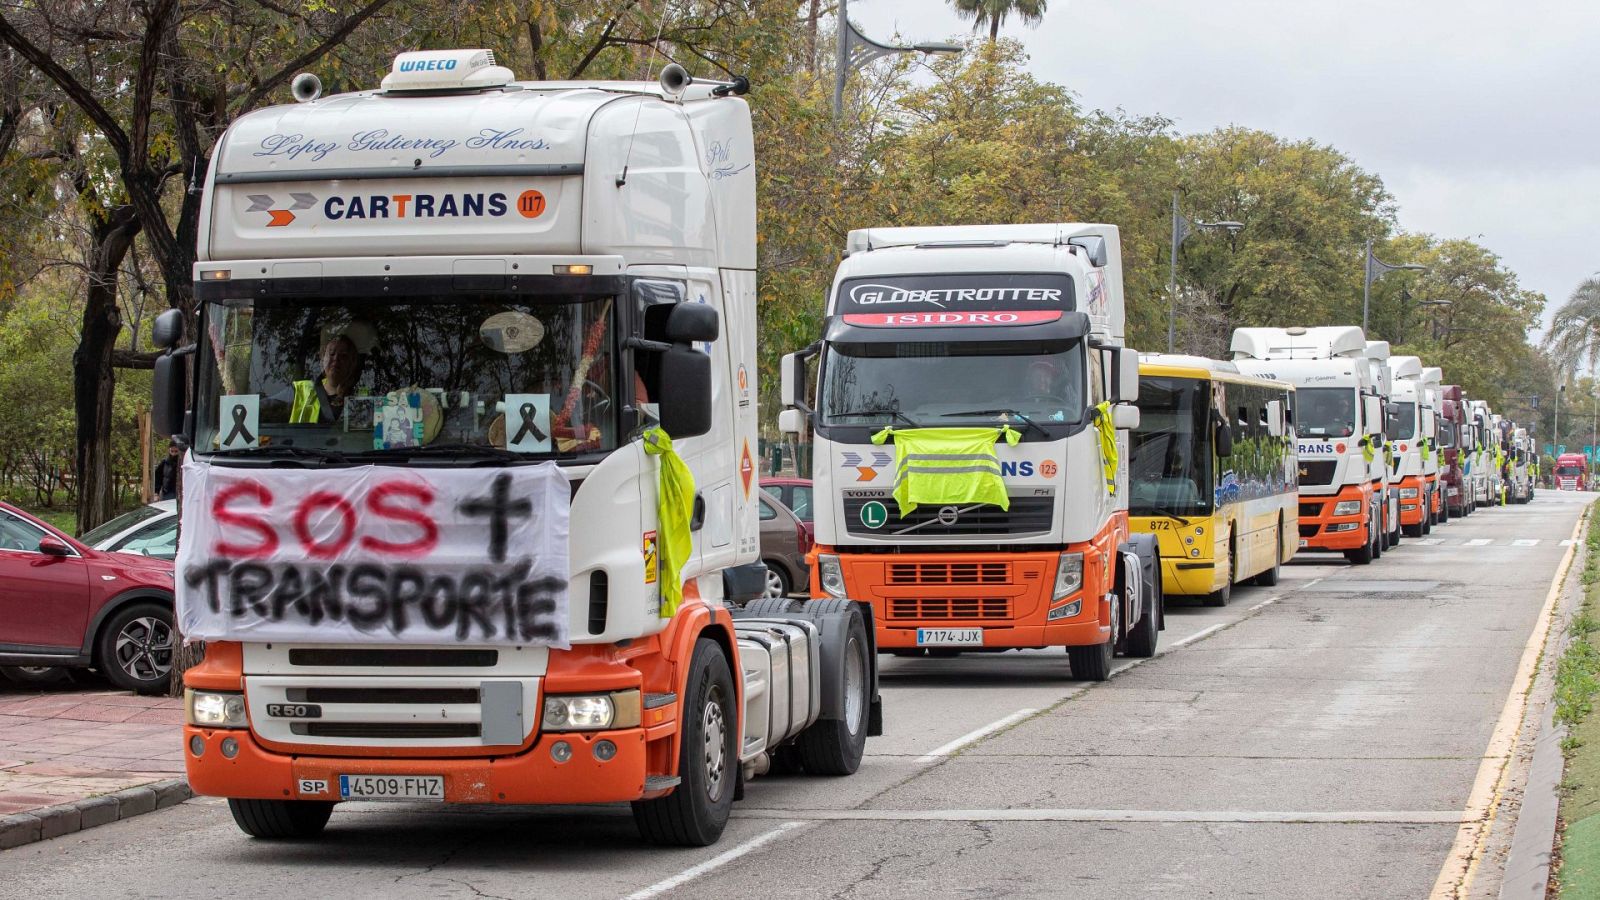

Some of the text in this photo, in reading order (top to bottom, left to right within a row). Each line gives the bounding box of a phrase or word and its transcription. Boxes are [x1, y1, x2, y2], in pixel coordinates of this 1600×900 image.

[400, 59, 457, 73] WAECO
[347, 128, 462, 159] Gutierrez
[465, 127, 550, 151] Hnos.
[324, 192, 508, 220] CARTRANS
[520, 194, 542, 213] 117
[850, 284, 1062, 307] GLOBETROTTER
[885, 312, 1019, 324] ISIDRO
[1298, 444, 1333, 454] RANS
[1001, 461, 1034, 477] NS
[1040, 462, 1057, 475] 125
[847, 490, 885, 498] VOLVO
[1033, 488, 1050, 496] FH
[211, 479, 438, 558] SOS
[868, 506, 880, 524] L
[1150, 521, 1170, 530] 872
[184, 558, 568, 641] TRANSPORTE
[926, 631, 979, 642] 7174 JJX
[302, 781, 325, 792] SP
[353, 778, 439, 796] 4509 FHZ
